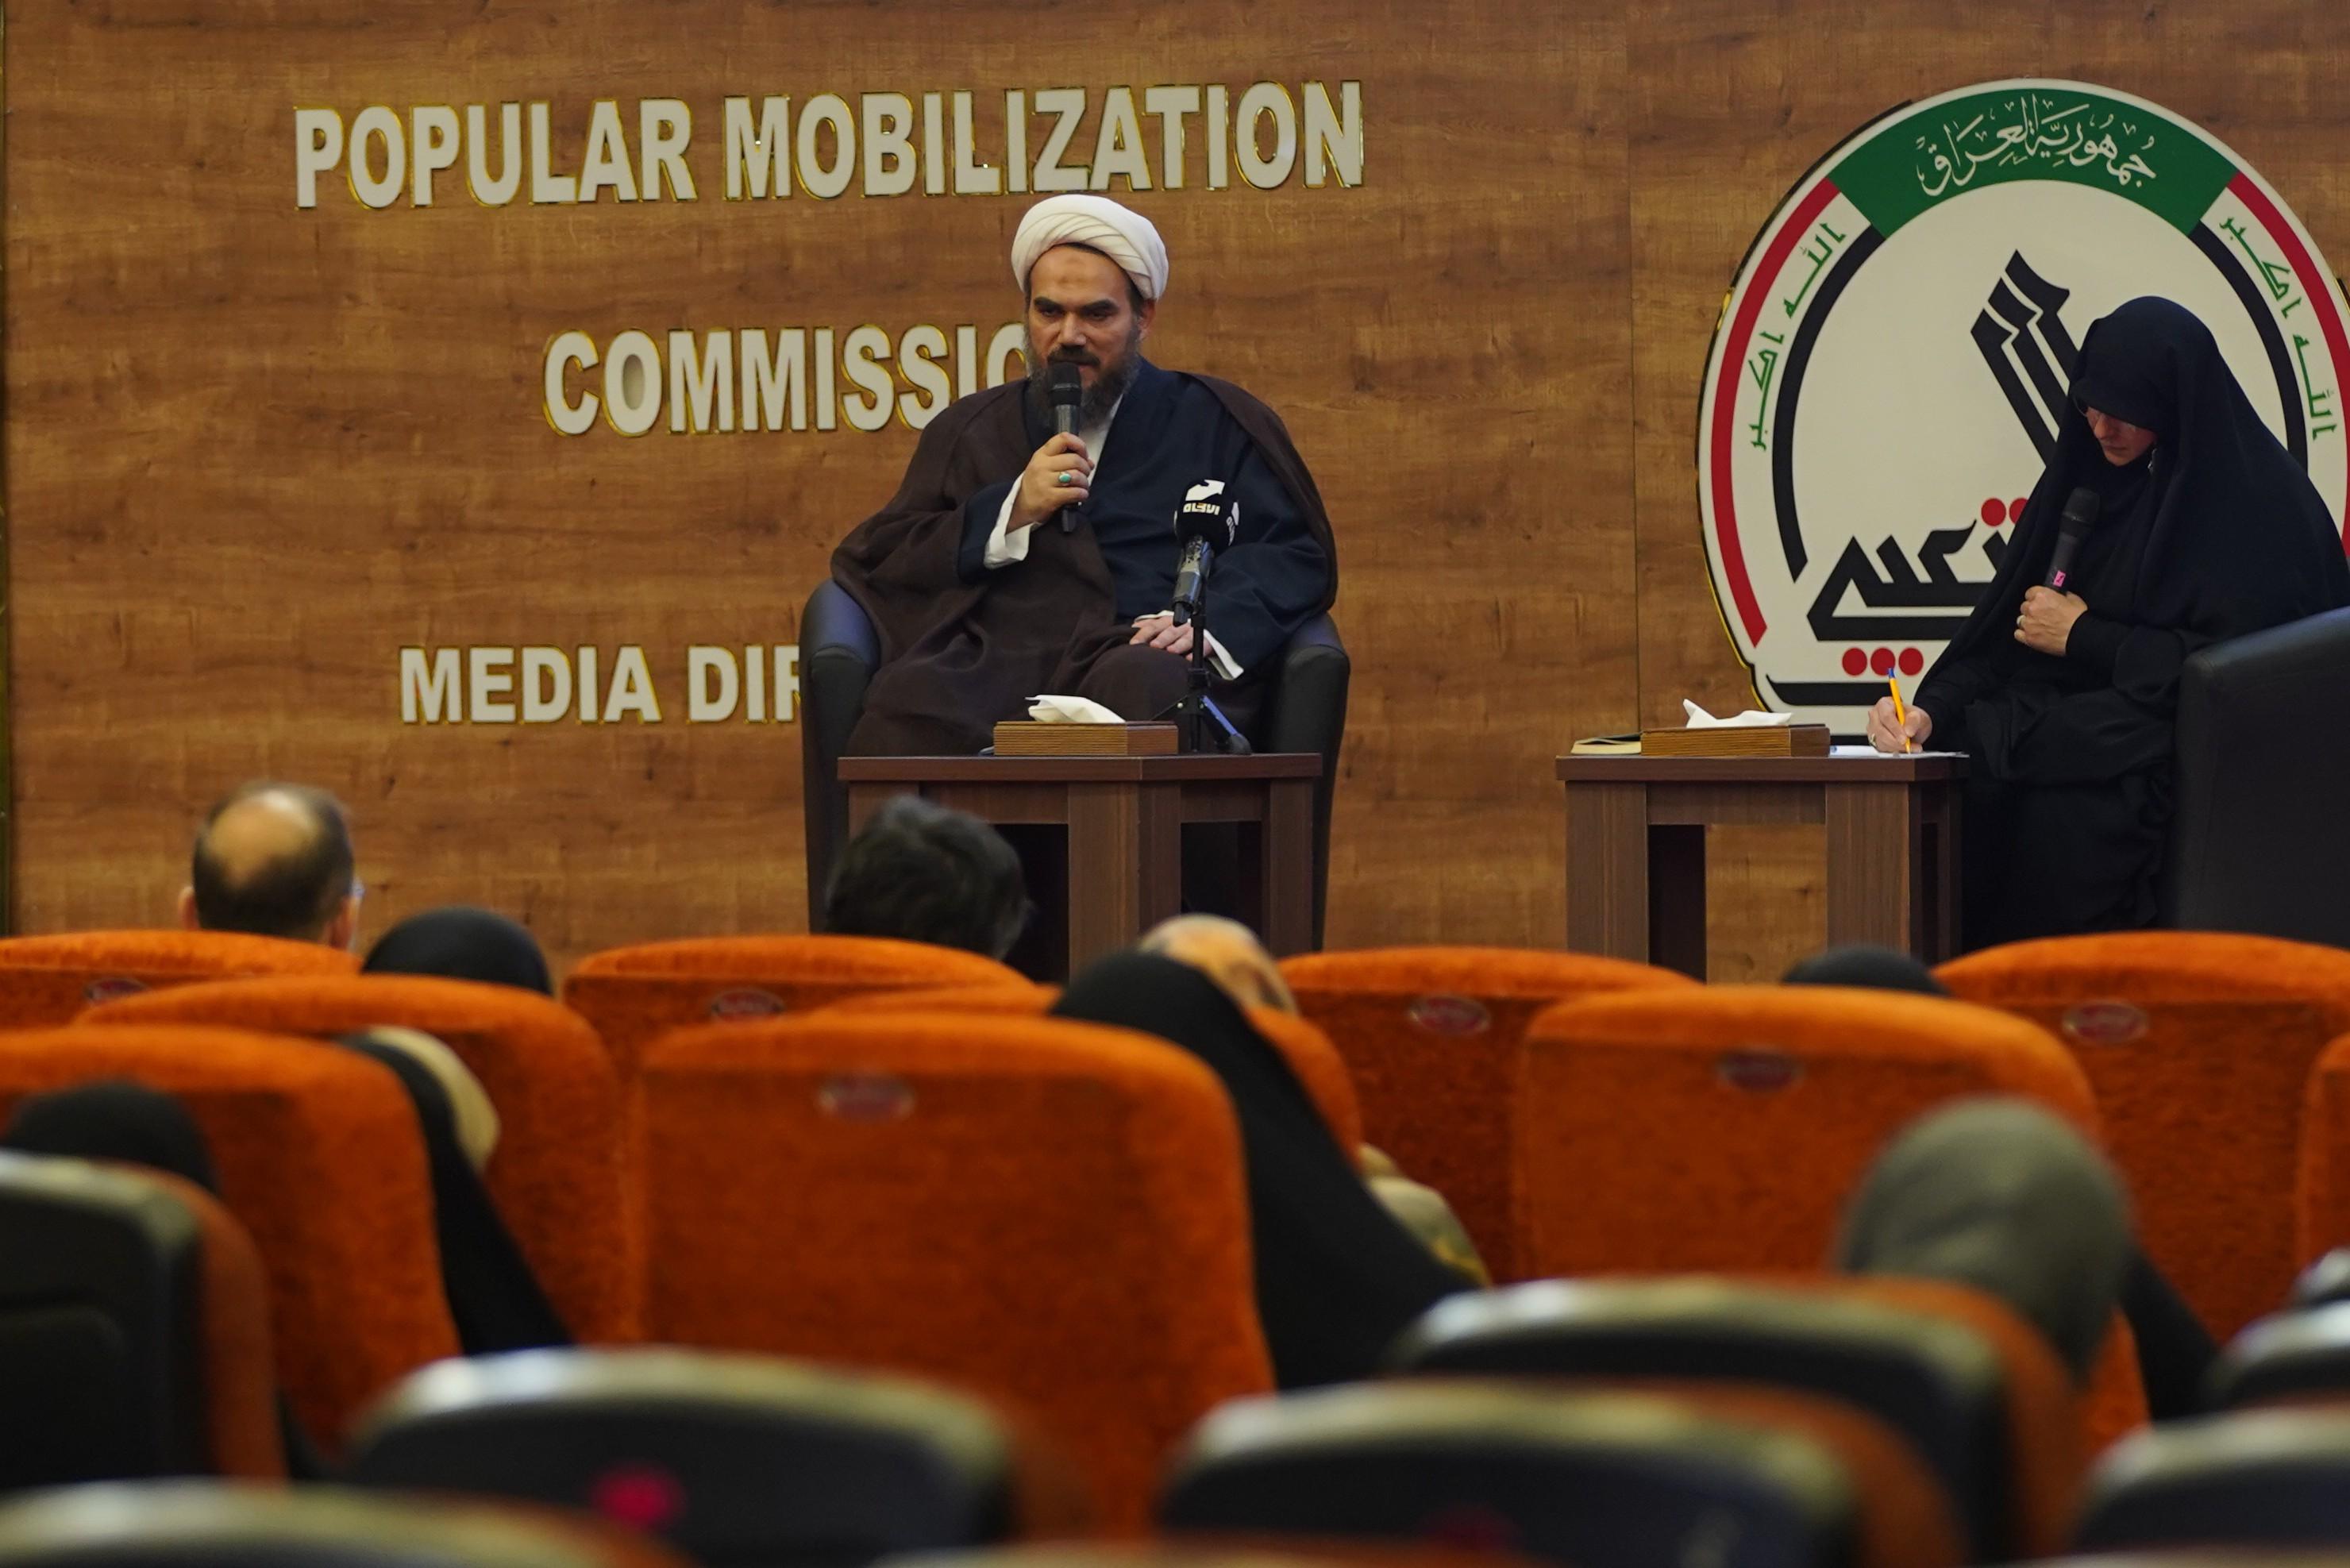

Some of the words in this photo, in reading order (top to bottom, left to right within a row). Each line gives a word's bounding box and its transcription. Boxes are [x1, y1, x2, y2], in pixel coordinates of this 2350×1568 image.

[294, 96, 699, 210] POPULAR
[722, 79, 1365, 200] MOBILIZATION
[399, 643, 663, 726] MEDIA
